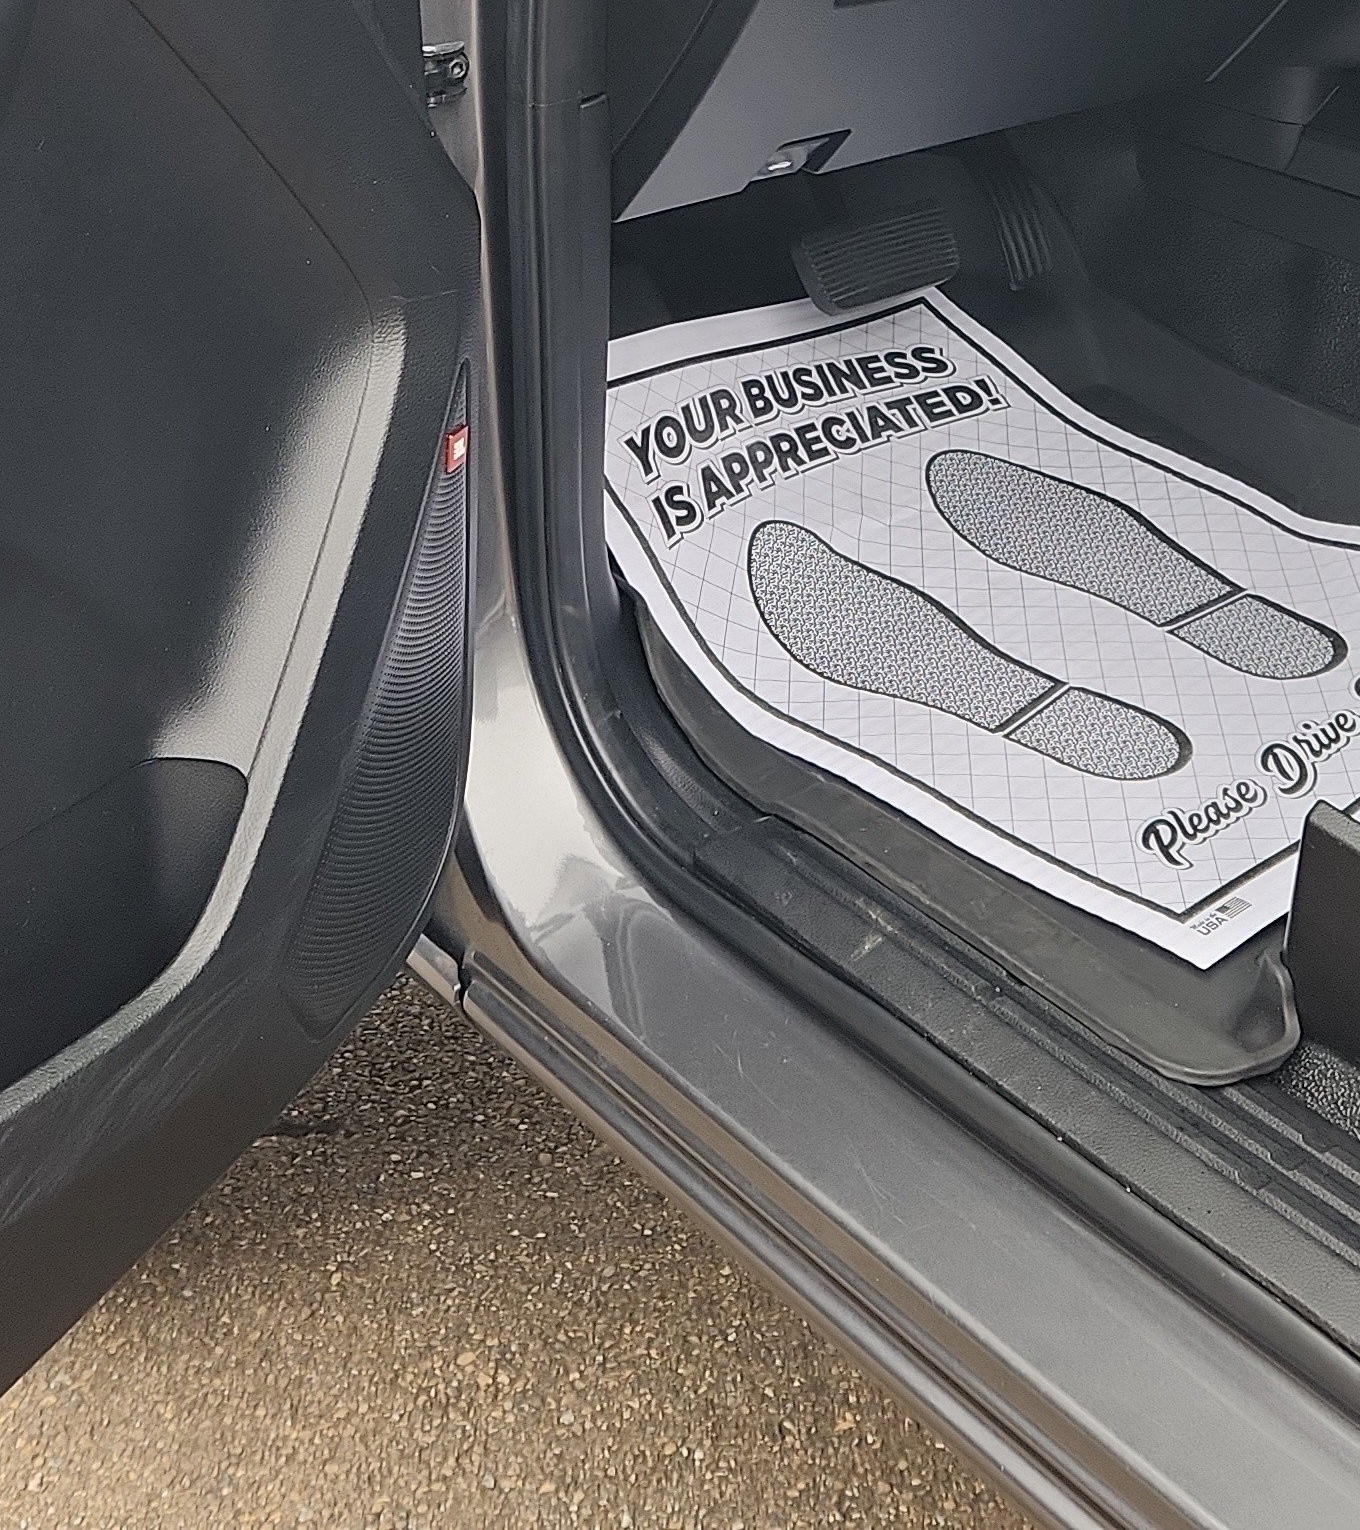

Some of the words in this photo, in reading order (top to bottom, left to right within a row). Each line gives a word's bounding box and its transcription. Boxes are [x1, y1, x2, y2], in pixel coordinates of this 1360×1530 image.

[623, 385, 744, 477] YOUR
[741, 345, 951, 420] BUSINESS
[649, 482, 698, 541] IS
[700, 377, 1008, 514] APPRECIATED!
[1140, 780, 1260, 867] Please
[1260, 711, 1358, 796] Drive
[1197, 916, 1229, 936] USA
